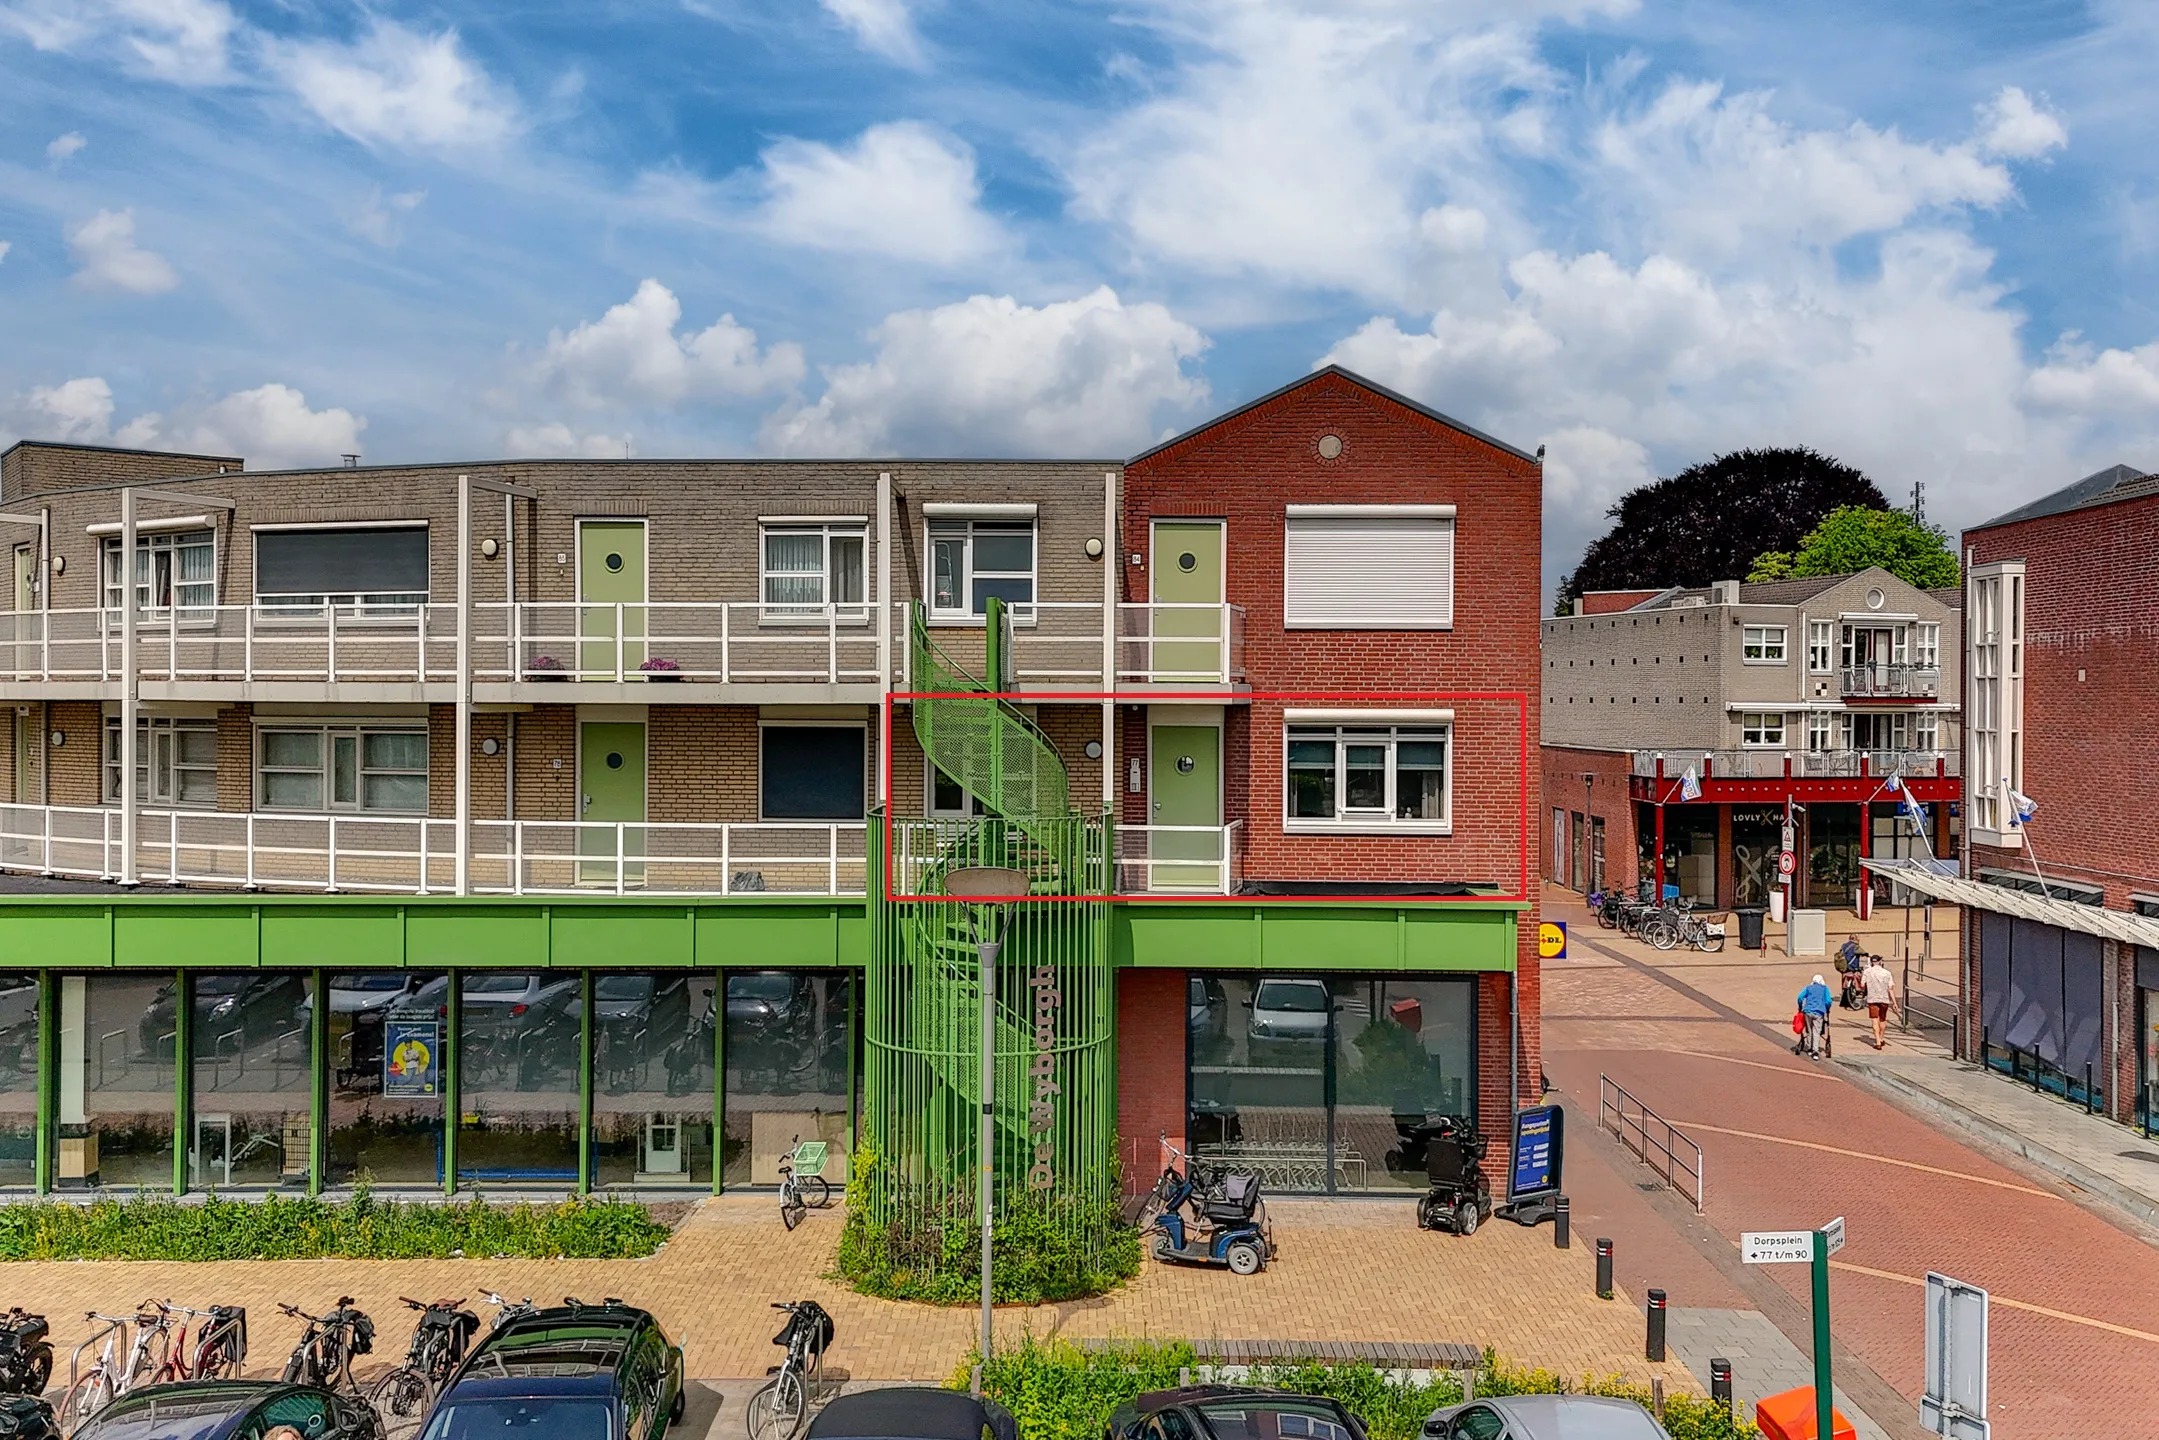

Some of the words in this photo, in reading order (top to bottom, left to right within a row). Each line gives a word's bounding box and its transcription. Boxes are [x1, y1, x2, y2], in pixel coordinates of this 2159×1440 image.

[1733, 814, 1761, 822] LOVLY
[1028, 965, 1061, 1134] Wyborgh
[1028, 1142, 1054, 1189] De
[1754, 1236, 1803, 1246] Dorpsplein
[1760, 1251, 1773, 1259] 77
[1775, 1251, 1793, 1259] t/m
[1795, 1250, 1808, 1259] 90
